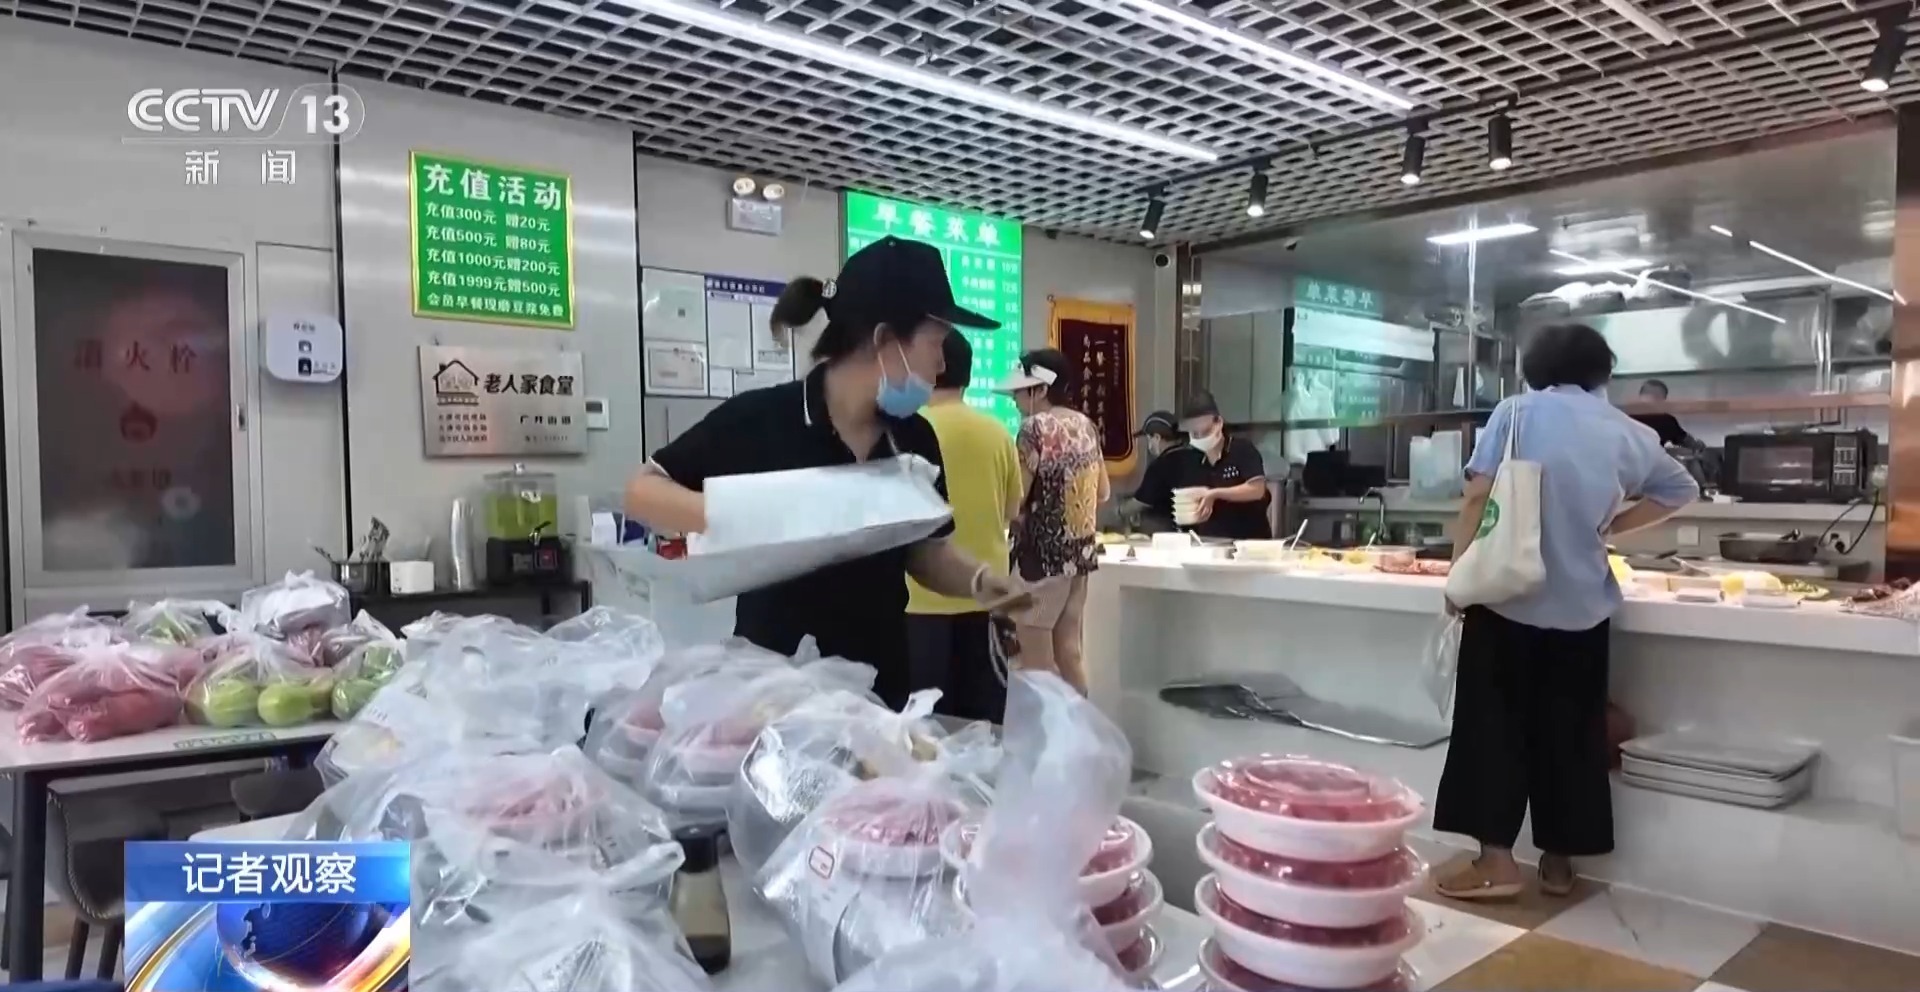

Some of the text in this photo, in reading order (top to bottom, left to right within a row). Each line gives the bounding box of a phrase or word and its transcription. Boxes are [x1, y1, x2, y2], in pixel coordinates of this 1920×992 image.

[423, 164, 561, 211] 充值活动
[425, 202, 551, 232] 充值300元 赠20元
[872, 201, 1000, 248] 早餐菜单
[425, 225, 551, 254] 充值500元 赠80元
[426, 248, 560, 277] 充值1000元赠200元
[427, 270, 560, 297] 充值1999元赠500元
[427, 292, 563, 317] 会员早餐现磨豆浆免费
[484, 373, 574, 396] 老人家食堂
